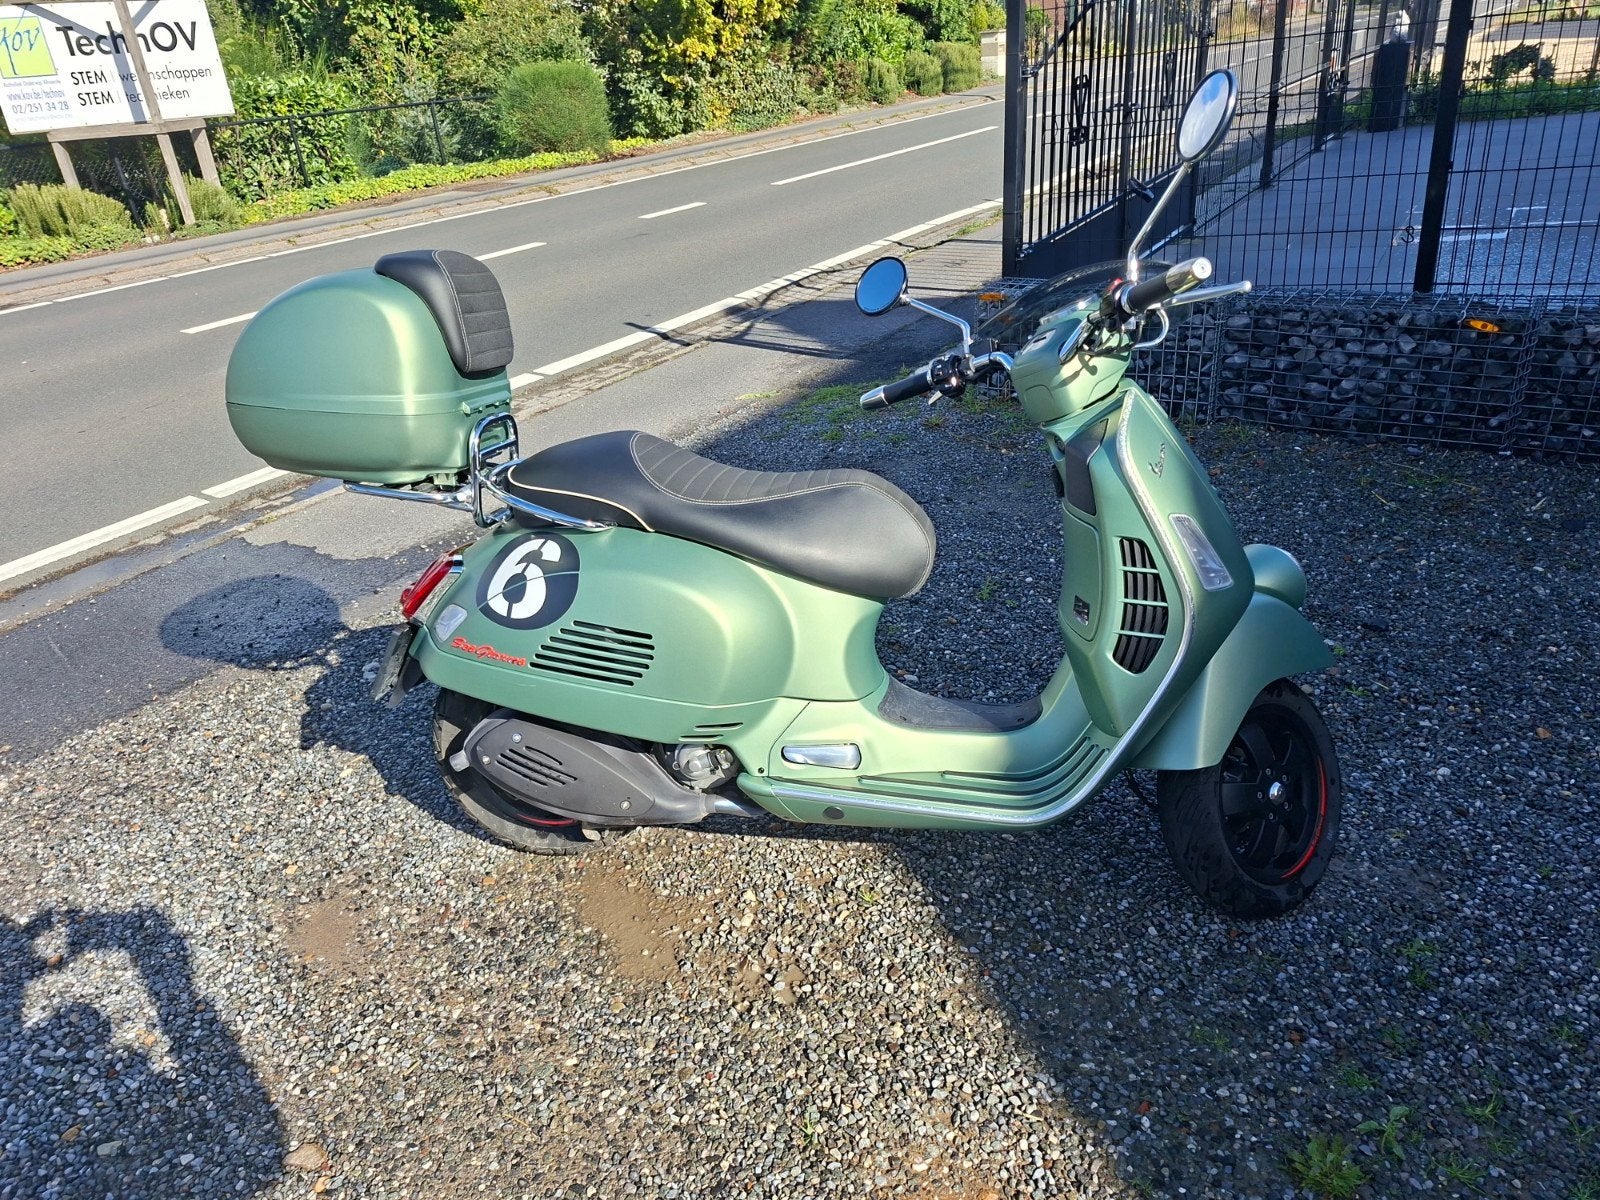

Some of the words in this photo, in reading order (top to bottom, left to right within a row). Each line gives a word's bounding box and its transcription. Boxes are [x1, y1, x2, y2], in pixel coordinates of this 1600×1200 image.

[55, 20, 197, 57] TechnOV
[70, 70, 108, 86] STEM
[77, 90, 115, 107] STEM
[11, 102, 43, 115] 02/251
[45, 101, 57, 112] 34
[58, 100, 70, 111] 28
[486, 538, 562, 620] 6
